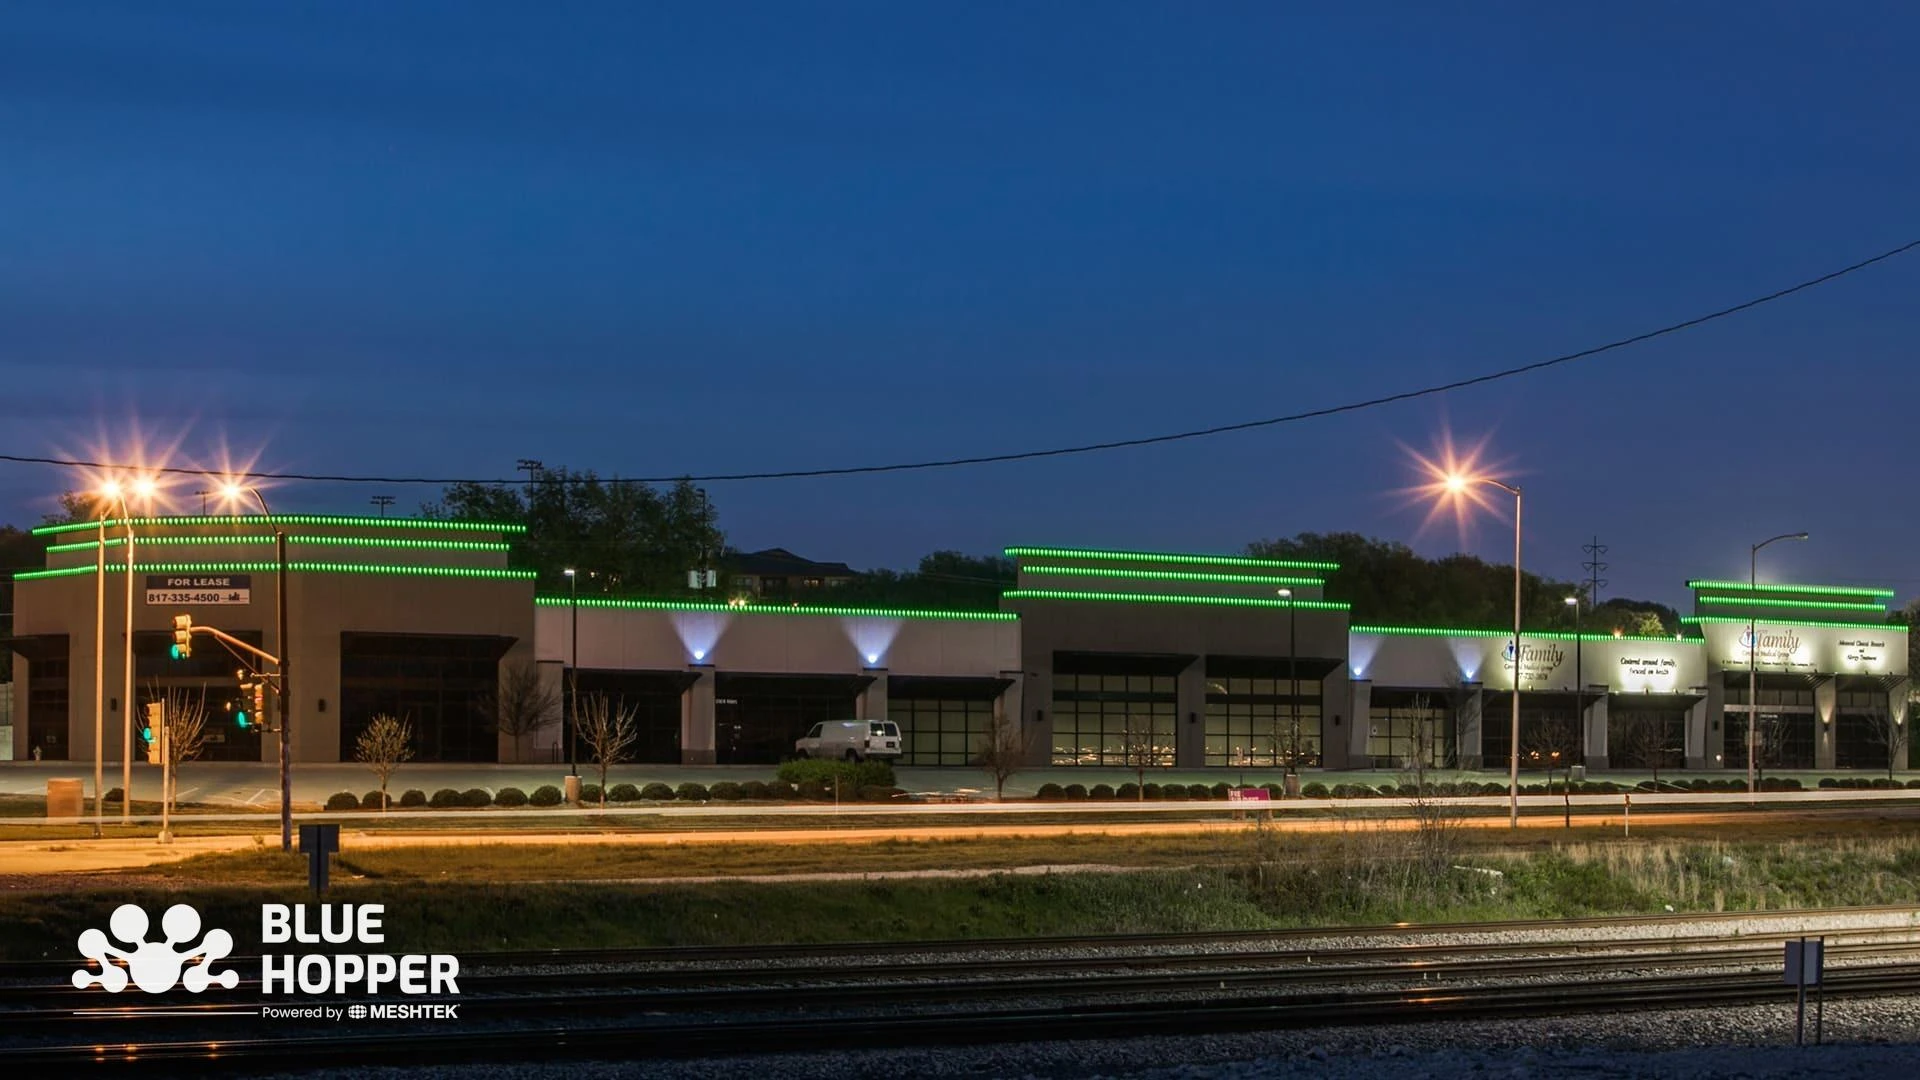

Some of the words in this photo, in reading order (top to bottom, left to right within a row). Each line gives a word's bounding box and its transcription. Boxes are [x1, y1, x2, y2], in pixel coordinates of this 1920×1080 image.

[167, 578, 190, 586] FOR
[193, 578, 230, 586] LEASE
[148, 593, 220, 602] 817-335-4500
[1756, 629, 1800, 654] Family
[1519, 644, 1565, 667] Family
